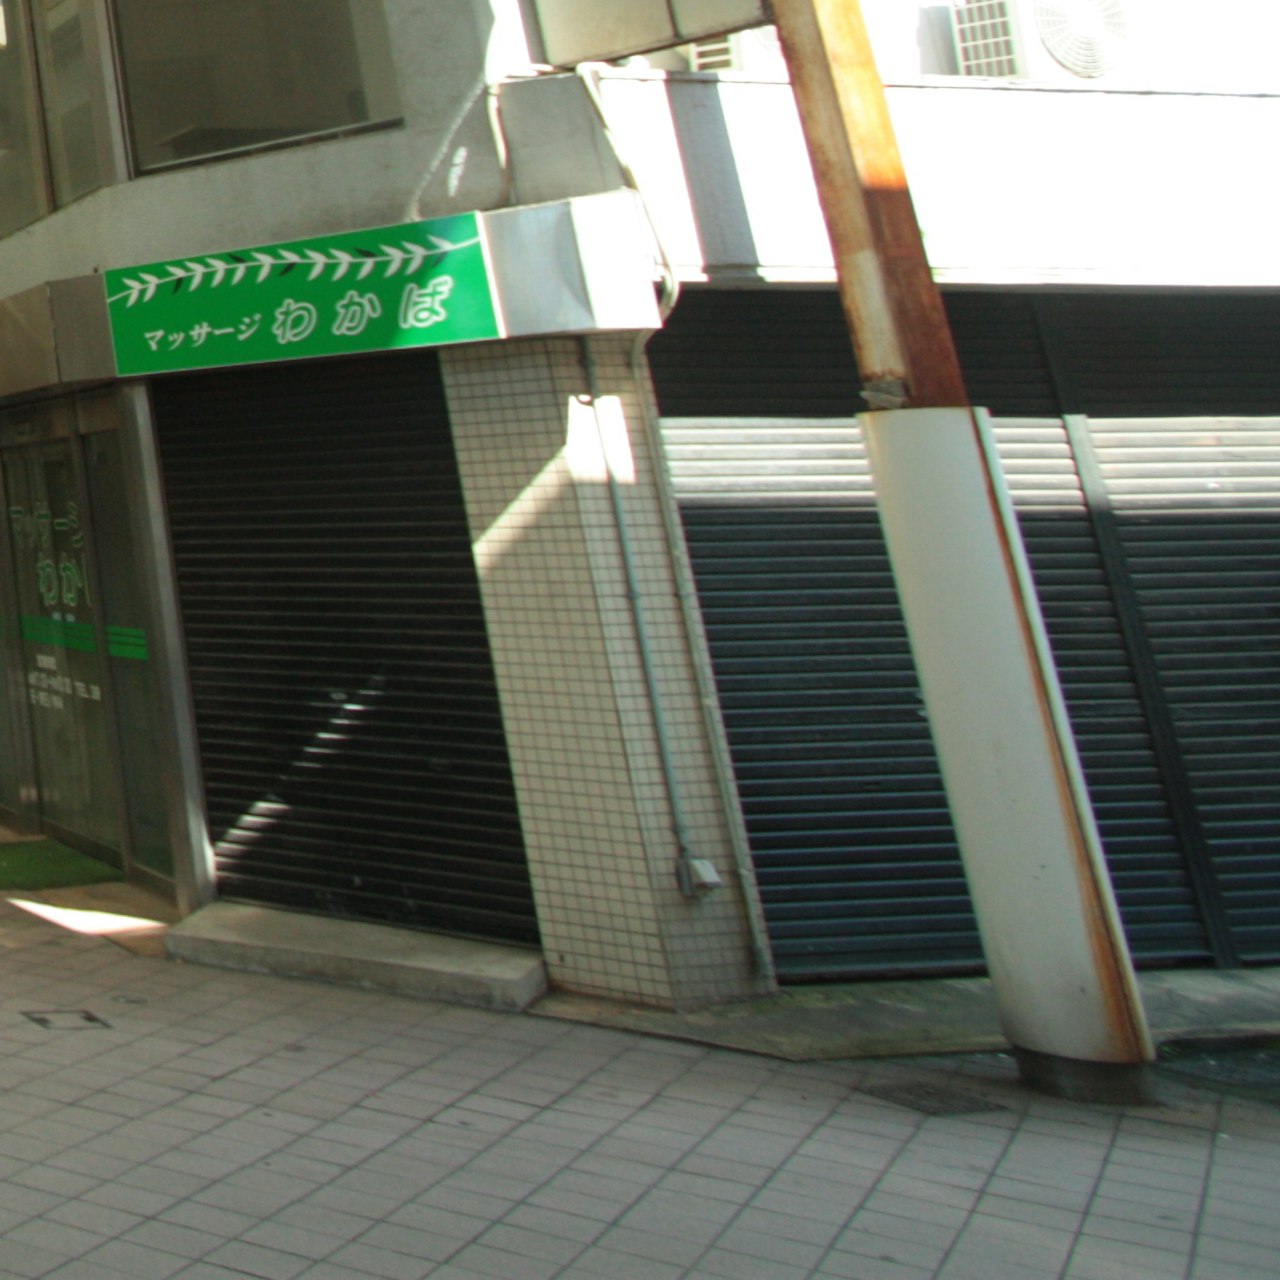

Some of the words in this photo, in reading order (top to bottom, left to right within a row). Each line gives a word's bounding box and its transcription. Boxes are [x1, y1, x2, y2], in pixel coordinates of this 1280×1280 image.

[144, 313, 262, 352] マッサージ
[272, 275, 454, 344] わかば
